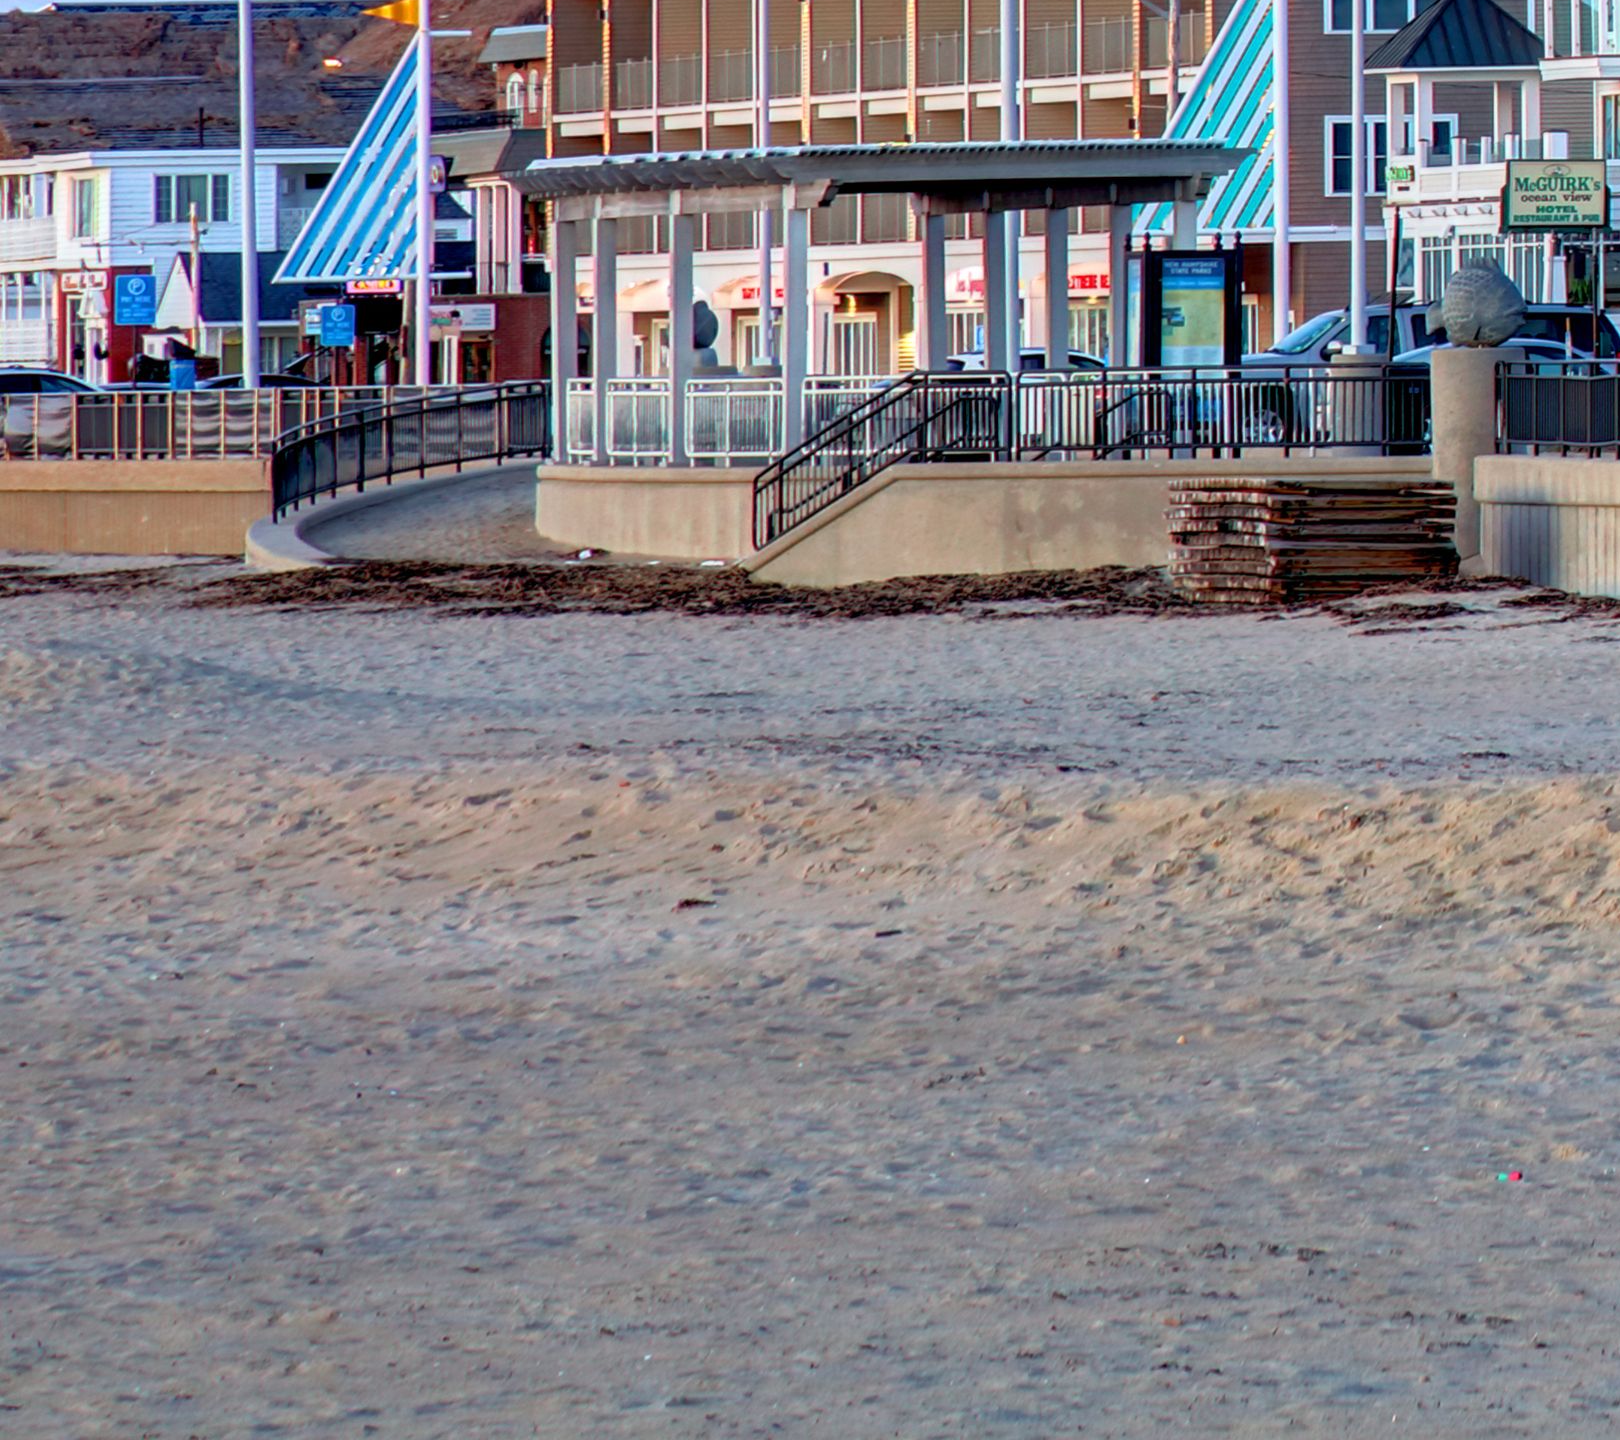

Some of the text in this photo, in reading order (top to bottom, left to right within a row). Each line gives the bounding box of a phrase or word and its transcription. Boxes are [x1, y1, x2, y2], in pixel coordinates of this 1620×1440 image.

[1514, 176, 1601, 192] McGUIRK's
[1520, 191, 1592, 202] ocean view
[1536, 205, 1578, 213] HOTEL
